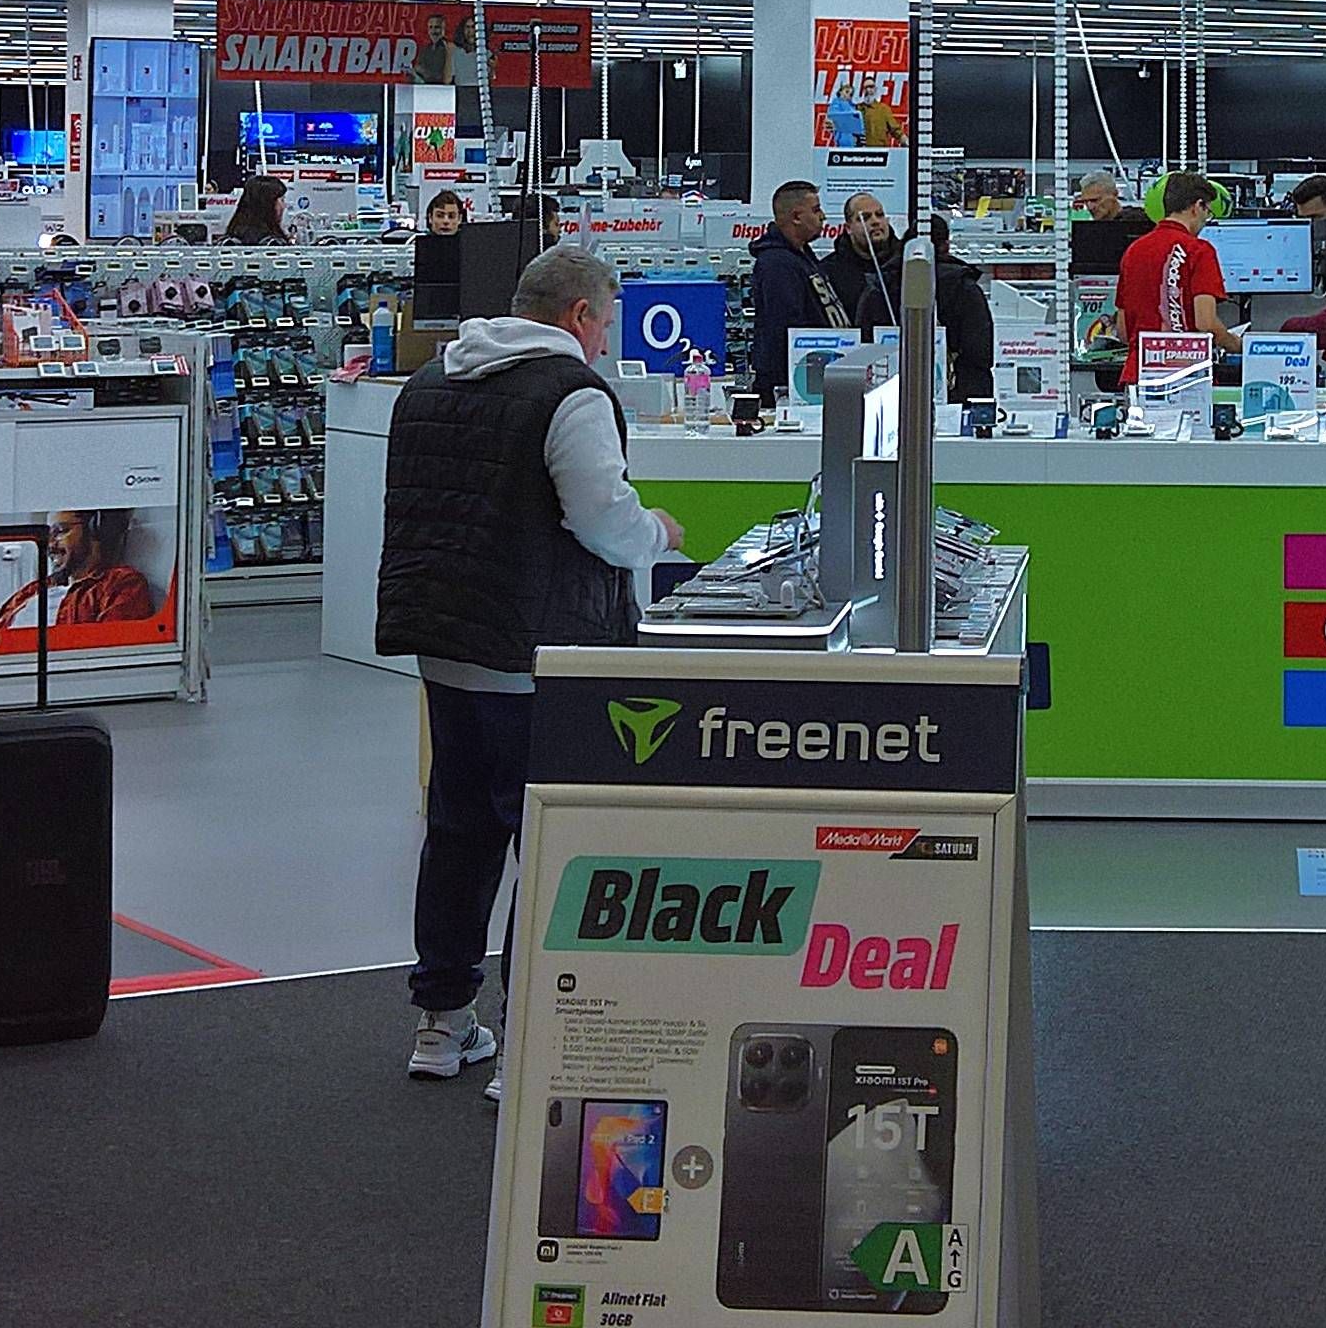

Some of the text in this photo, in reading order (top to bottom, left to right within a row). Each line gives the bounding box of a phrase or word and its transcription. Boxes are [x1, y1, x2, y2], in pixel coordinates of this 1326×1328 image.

[224, 0, 419, 35] SMARTBAR
[221, 33, 418, 74] SMARTBAR
[815, 22, 909, 63] LÄUFT
[1284, 355, 1311, 367] Deal
[698, 707, 941, 763] freenet
[934, 843, 973, 855] SATURN
[578, 867, 798, 945] Black
[800, 924, 960, 991] Deal
[555, 1007, 605, 1016] Smartphone
[913, 1077, 929, 1086] Pro
[847, 1104, 940, 1151] 15T
[948, 1228, 963, 1247] A
[882, 1229, 930, 1285] A
[947, 1271, 963, 1288] G
[601, 1291, 667, 1308] Allnet Flat
[600, 1313, 634, 1327] 30GB
